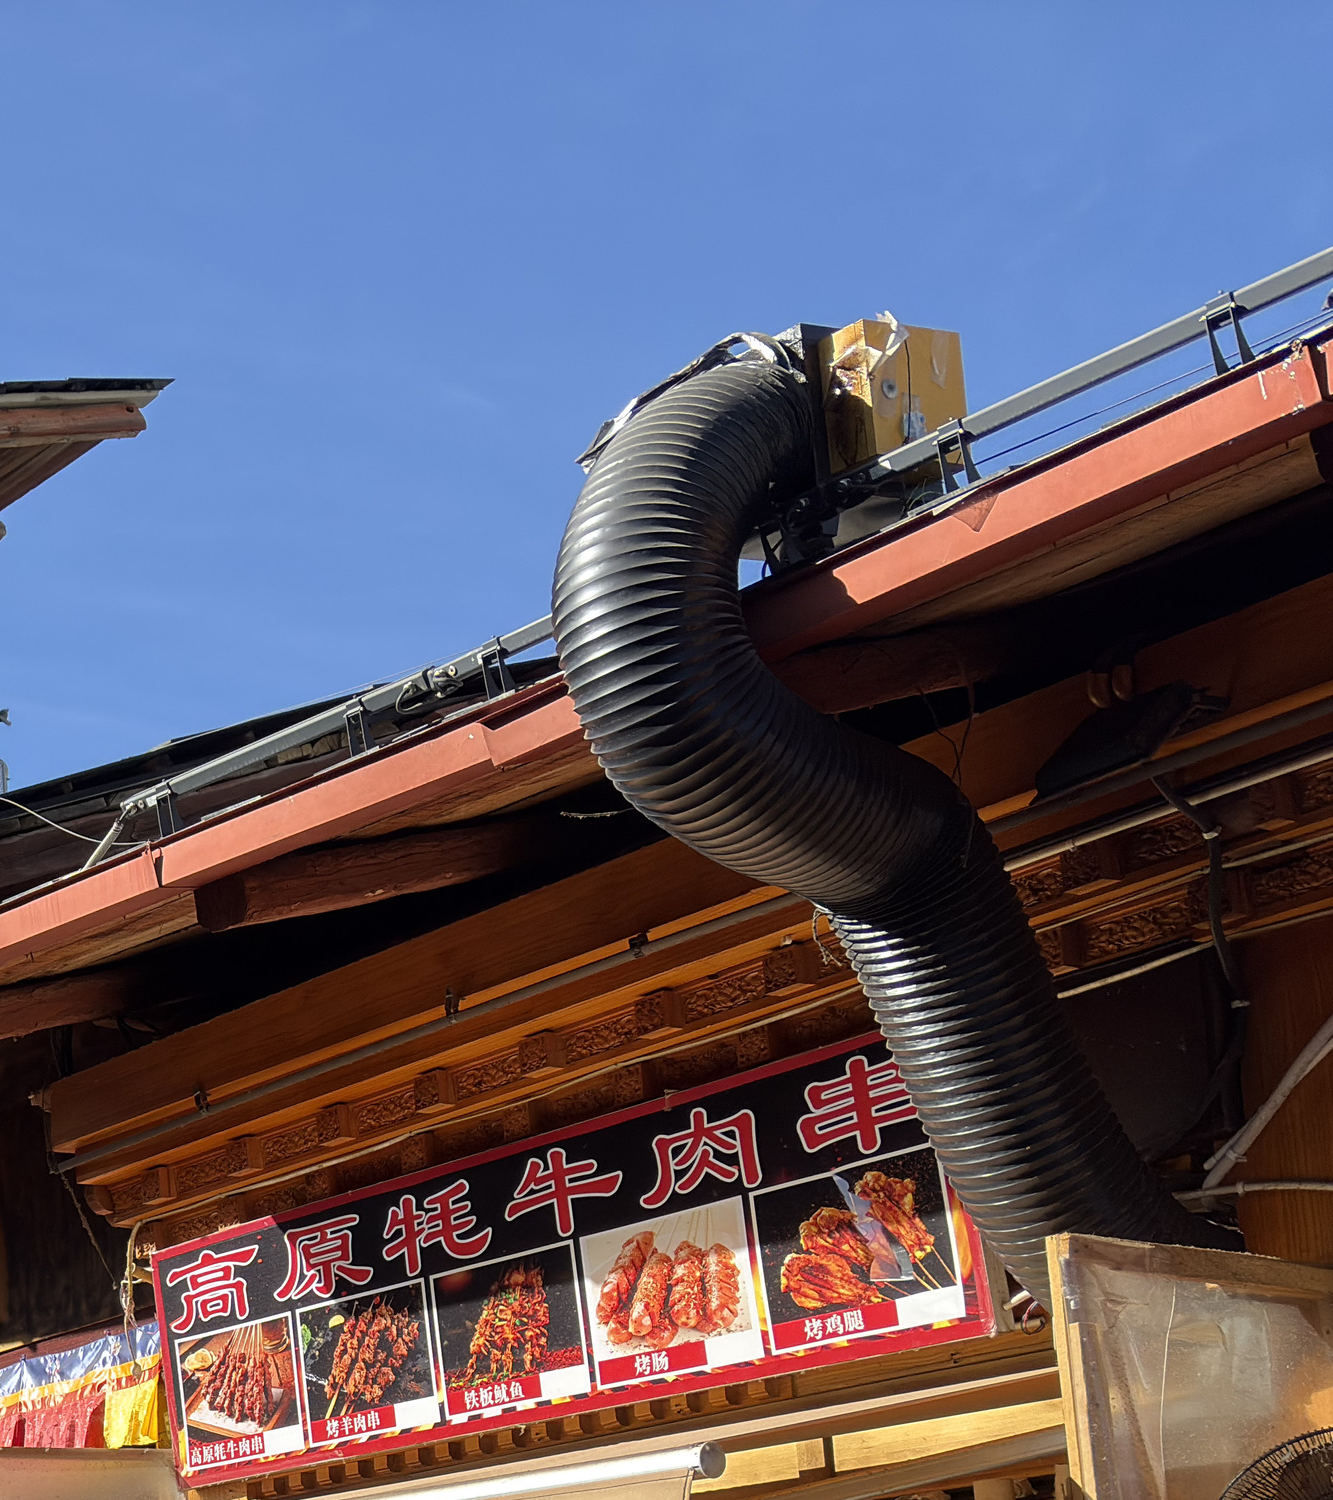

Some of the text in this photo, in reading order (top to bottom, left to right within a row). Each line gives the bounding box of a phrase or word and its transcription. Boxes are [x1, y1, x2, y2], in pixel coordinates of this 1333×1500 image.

[168, 1055, 917, 1334] 高原牦牛肉串
[804, 1309, 866, 1343] 烤鸡腿
[634, 1350, 670, 1375] 烤肠
[464, 1381, 525, 1411] 铁板鱿鱼
[325, 1411, 381, 1440] 烤羊肉串
[190, 1437, 264, 1465] 高原牦牛肉串
